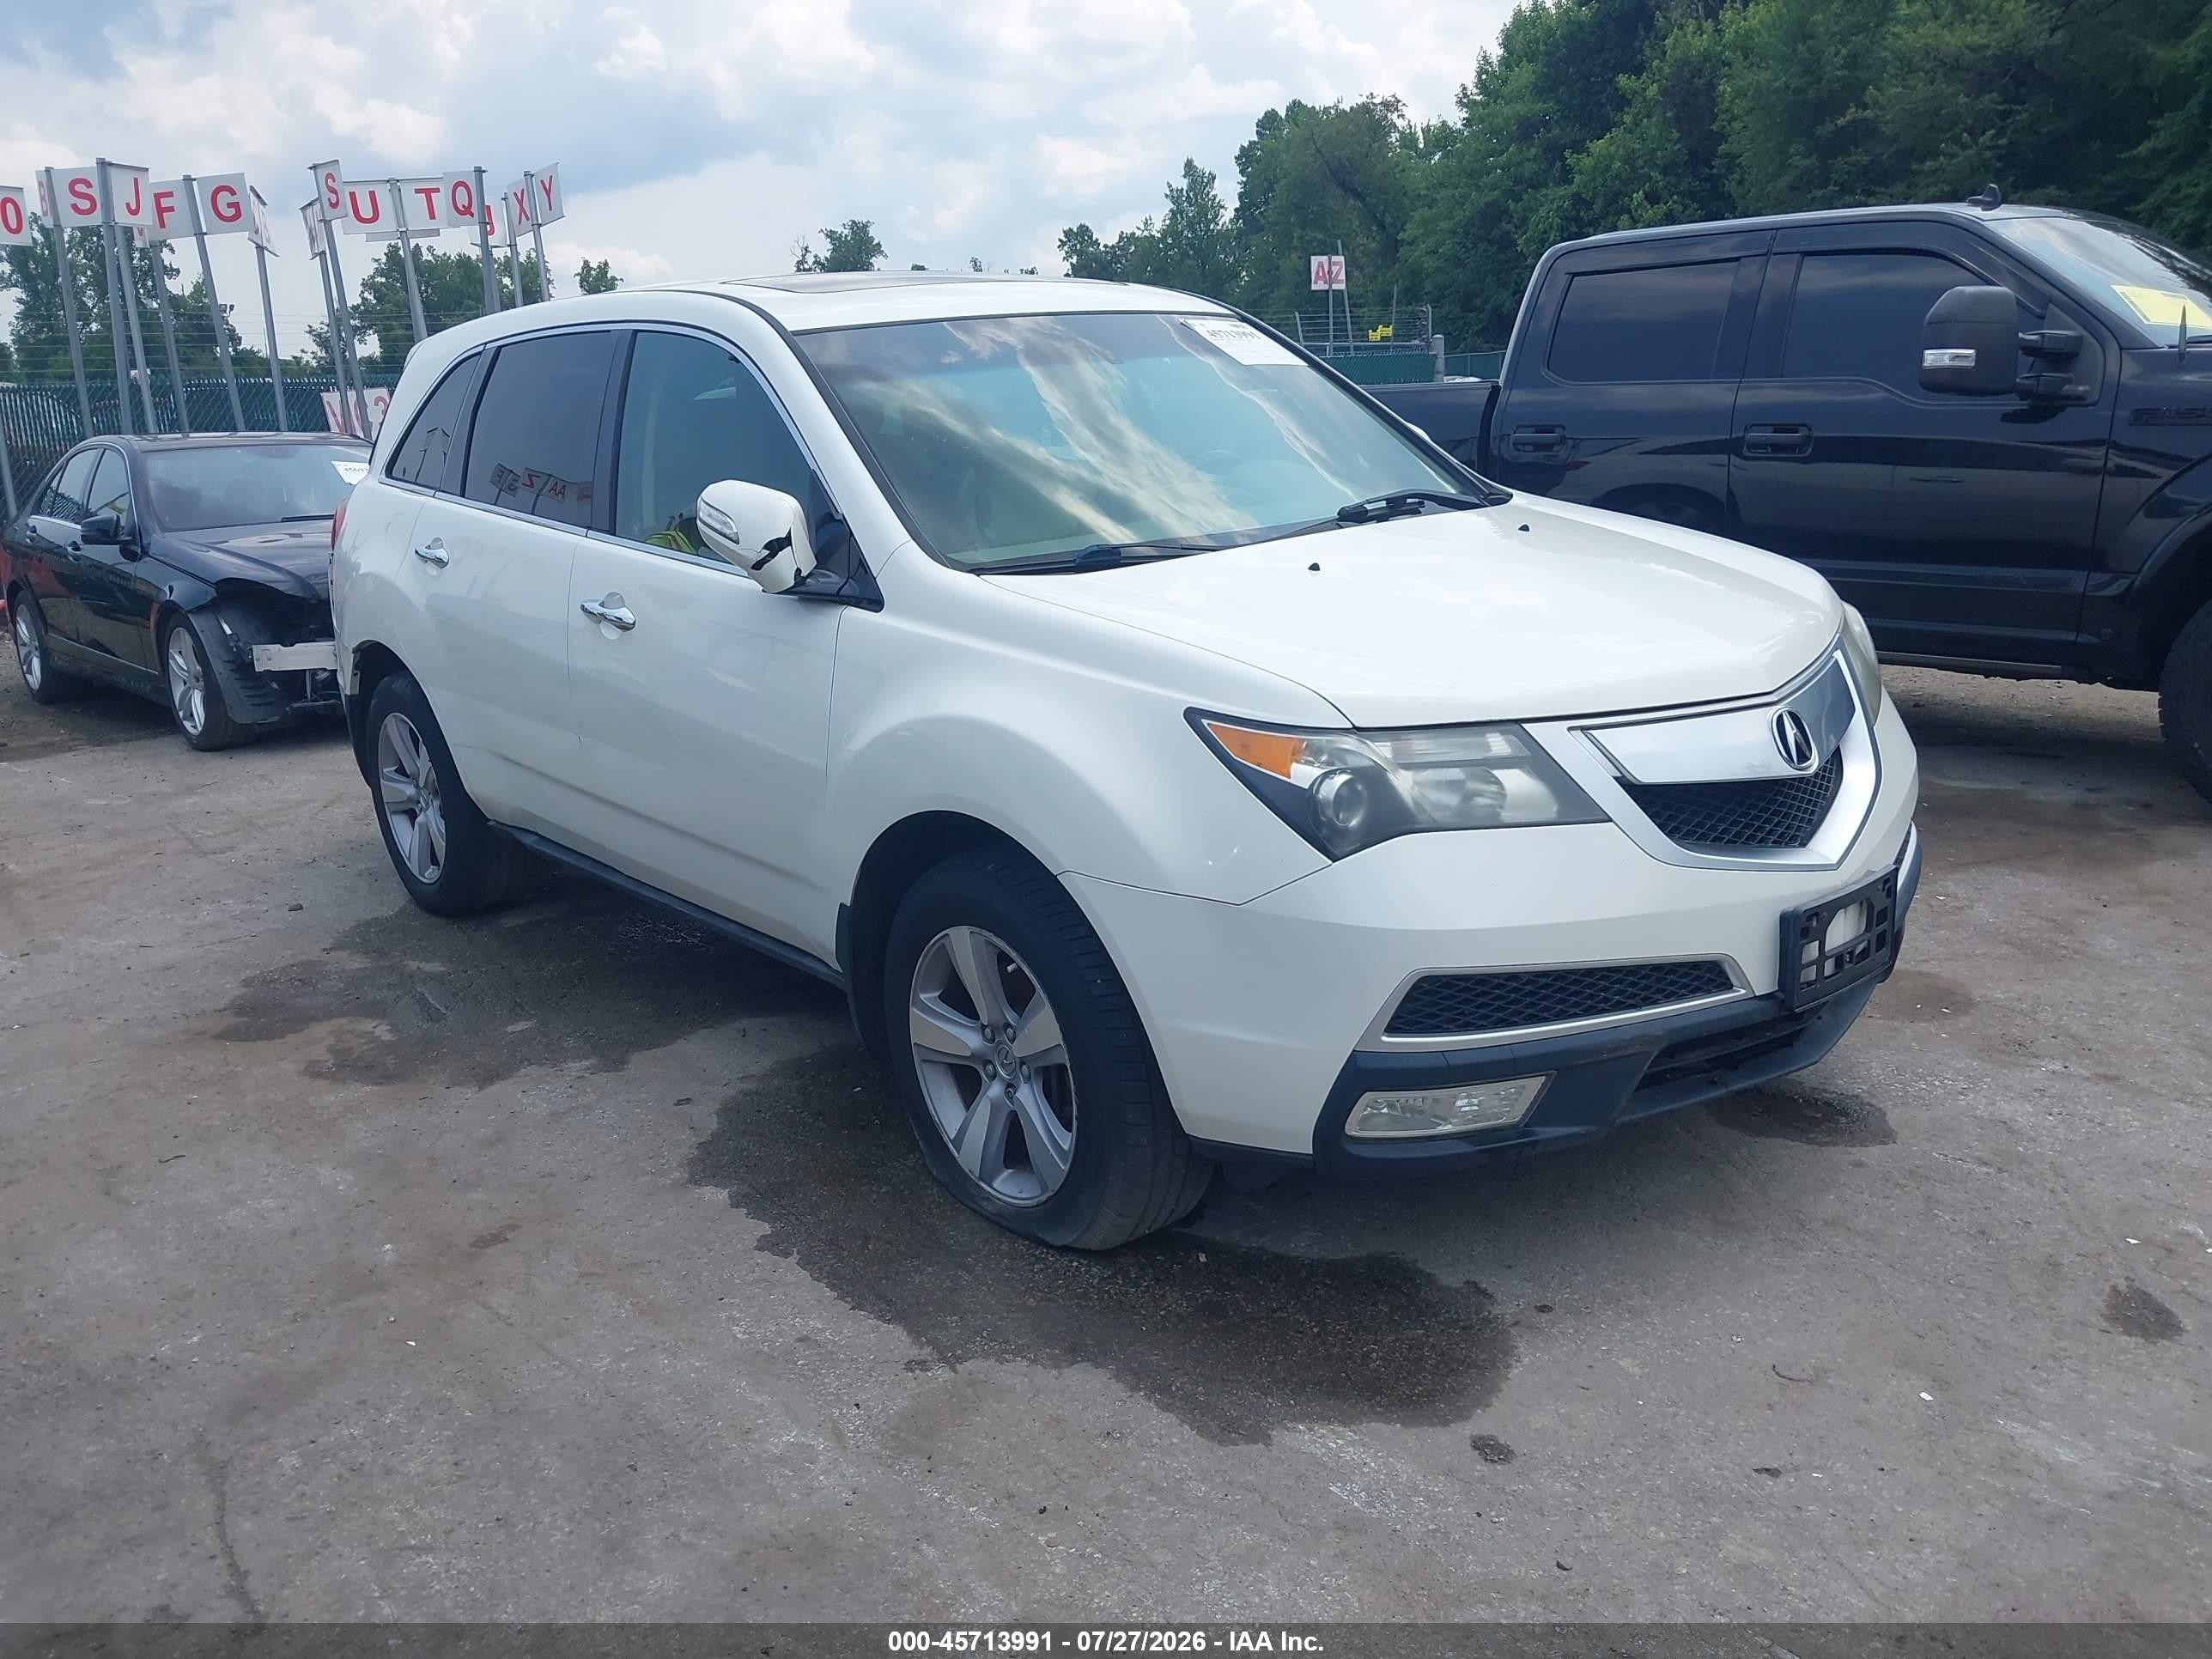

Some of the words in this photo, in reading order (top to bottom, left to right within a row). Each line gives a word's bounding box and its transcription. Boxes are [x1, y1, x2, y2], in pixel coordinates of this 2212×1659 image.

[68, 177, 97, 216] S
[125, 177, 141, 216] J
[153, 191, 175, 229] F
[210, 185, 242, 223] G
[325, 173, 340, 210] S
[349, 190, 380, 224] U
[414, 187, 441, 220] T
[451, 180, 475, 218] Q
[513, 188, 531, 225] X
[540, 174, 553, 212] Y
